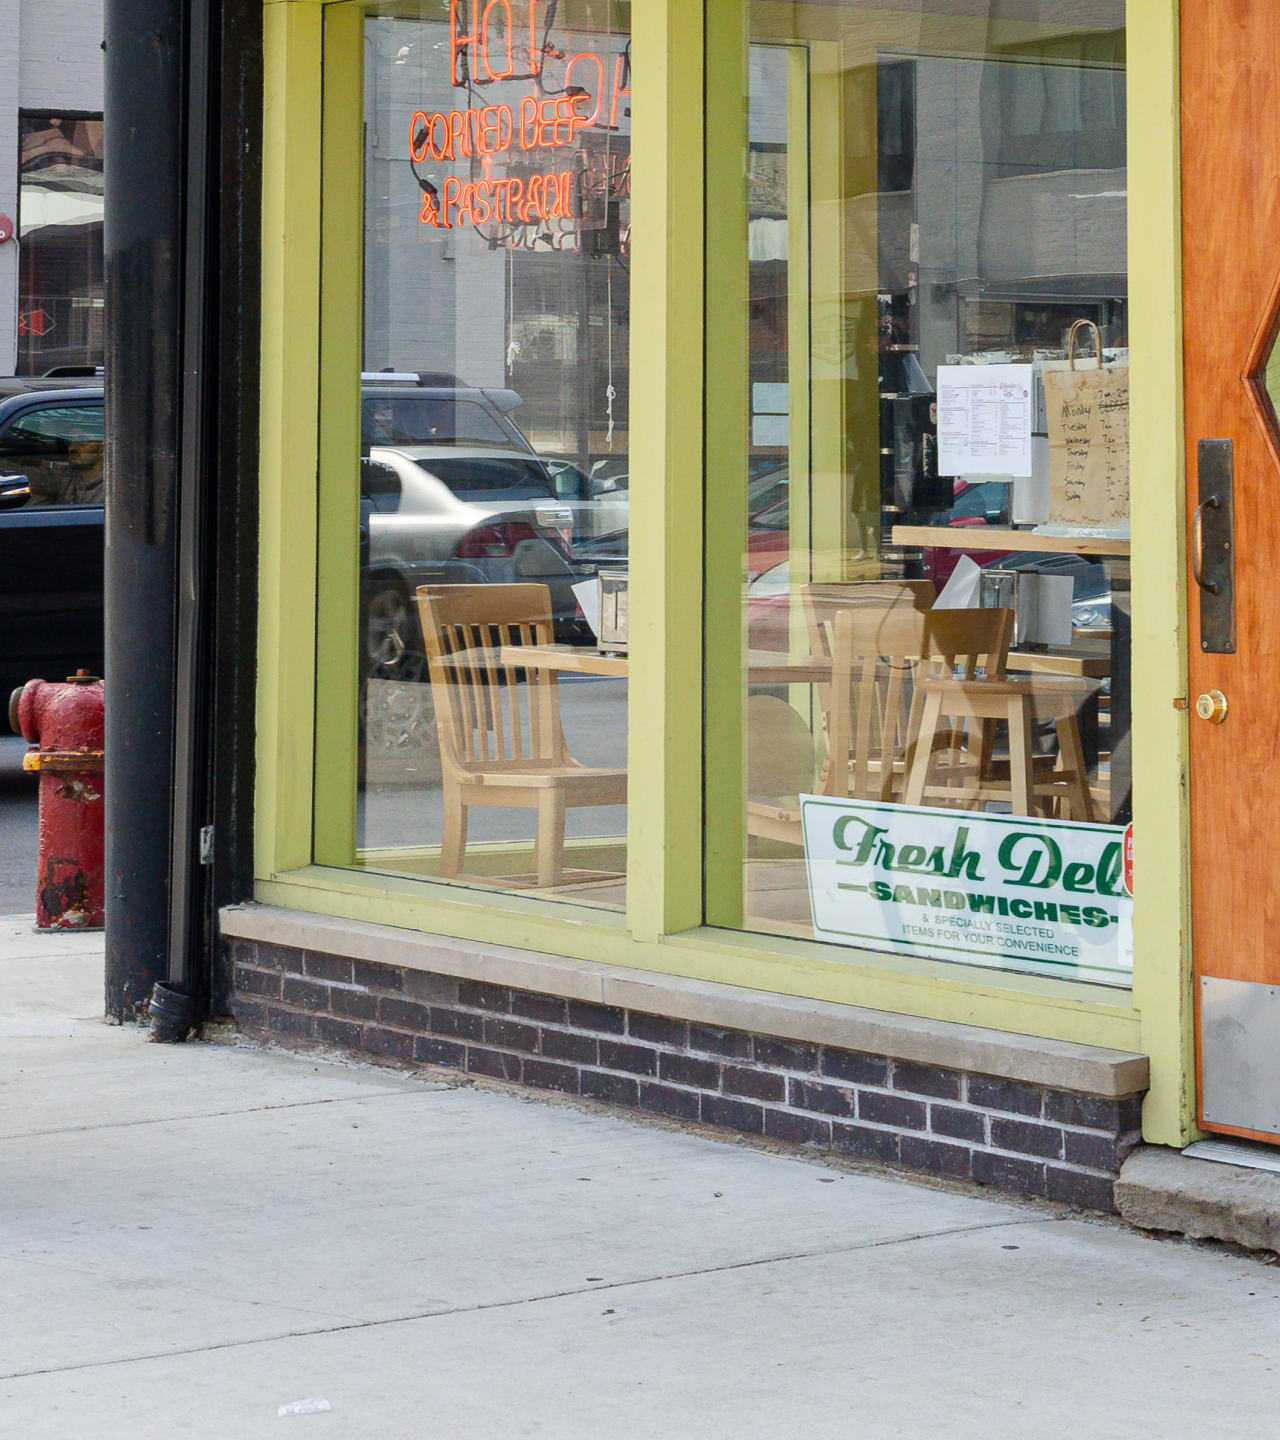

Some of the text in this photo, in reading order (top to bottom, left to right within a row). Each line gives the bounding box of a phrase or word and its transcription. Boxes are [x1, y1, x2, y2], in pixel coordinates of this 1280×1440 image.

[409, 94, 591, 162] CORNED BEEF
[419, 191, 440, 228] &
[442, 171, 574, 229] PASTRAMI
[1061, 403, 1092, 420] Monday
[832, 814, 985, 882] Fresh
[869, 880, 1111, 929] SANDWICHES
[921, 912, 1055, 939] & SPECIALLY SELECTED
[902, 925, 1080, 957] ITEMS FOR YOUR CONVENIENCE
